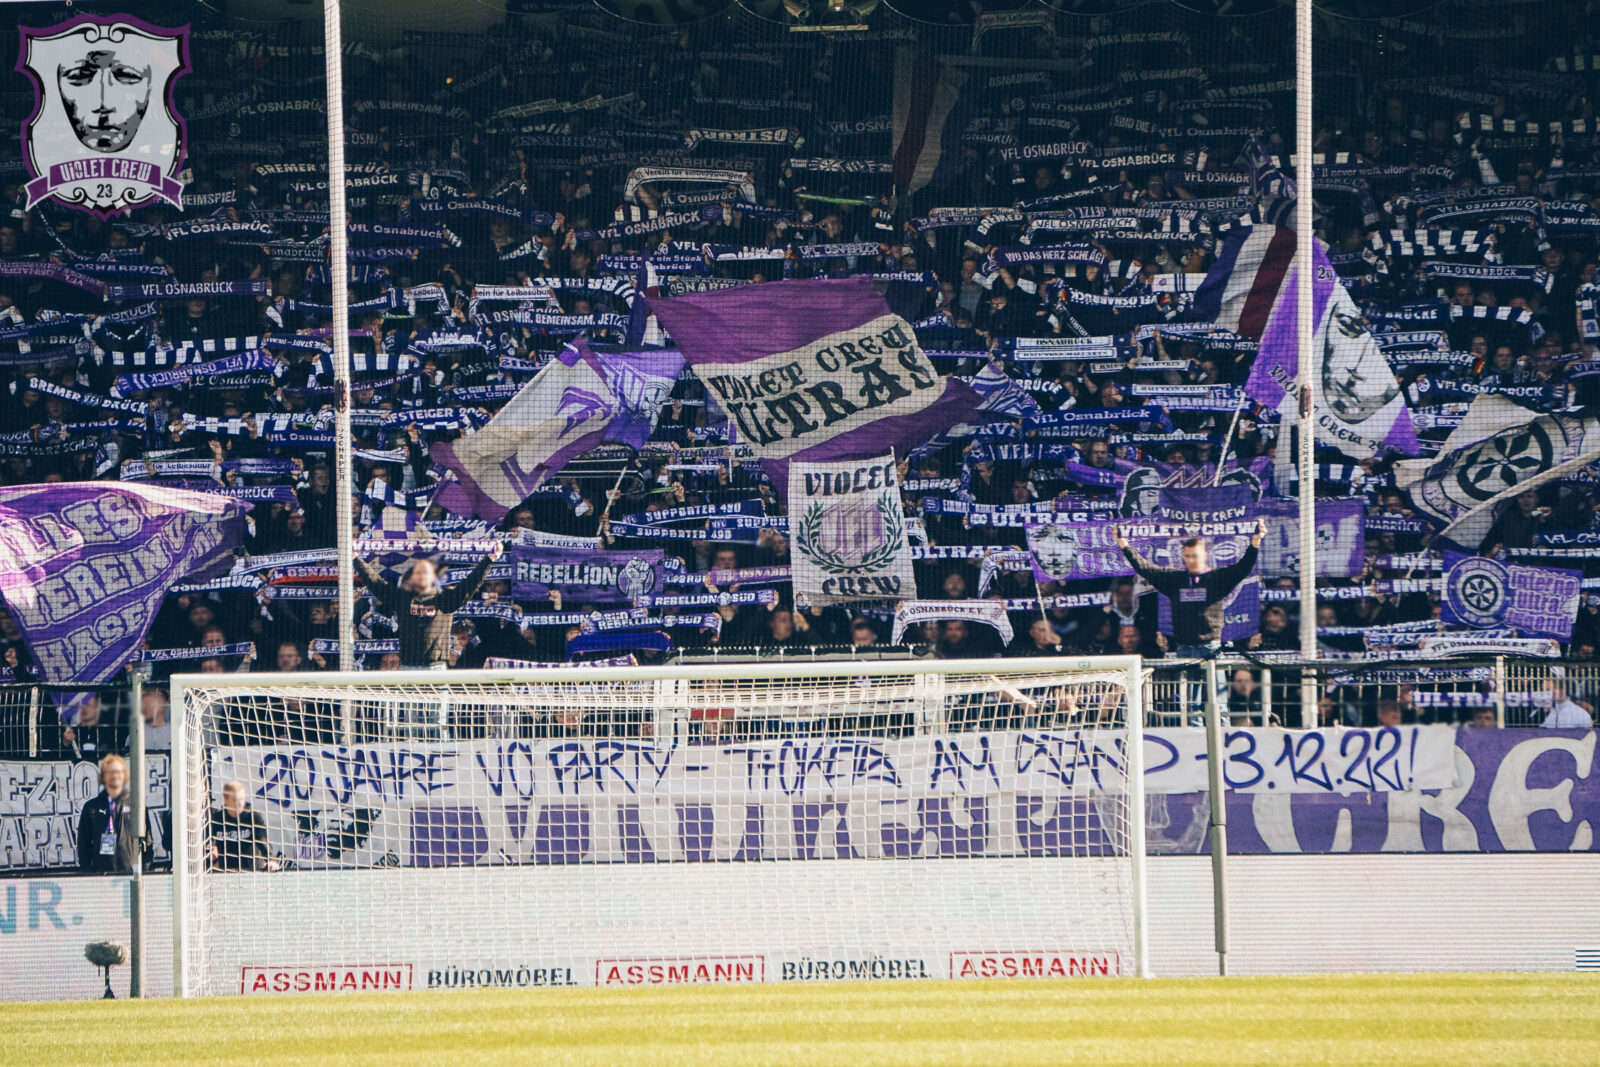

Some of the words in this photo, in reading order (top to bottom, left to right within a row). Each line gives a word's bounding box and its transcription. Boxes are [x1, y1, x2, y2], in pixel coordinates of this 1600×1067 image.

[1000, 147, 1022, 160] VFL
[1078, 158, 1100, 168] VFL
[1101, 152, 1176, 168] OSNABRÜCK
[256, 162, 316, 176] BREMER
[1206, 172, 1250, 184] OSNABR
[447, 200, 523, 218] Osnabrück
[977, 212, 1024, 236] BREMER
[1036, 220, 1058, 228] VFL
[673, 241, 700, 251] VFL
[1023, 251, 1042, 262] DAS
[1043, 249, 1066, 261] HERZ
[141, 284, 162, 296] VFL
[225, 356, 244, 370] VFL
[29, 376, 82, 402] BREMER
[1436, 379, 1460, 392] VFL
[1063, 409, 1150, 422] Osnabrück
[992, 512, 1089, 527] ULTRAS
[1212, 505, 1248, 522] CREW
[1119, 523, 1181, 537] VIOLET
[1198, 521, 1260, 536] CREW
[438, 541, 496, 553] CREW
[821, 574, 902, 597] CREW
[654, 594, 718, 607] REBELLION
[731, 592, 756, 604] SÜD
[1054, 592, 1112, 608] CREW
[526, 614, 590, 626] REBELLION
[676, 614, 702, 625] SÜD
[256, 750, 316, 808] 20
[321, 746, 460, 806] JAHRE
[546, 740, 678, 795] PARTY
[930, 735, 1000, 790] AM
[252, 971, 402, 993] ASSMANN
[427, 964, 578, 989] BÜROMÖBEL
[606, 962, 754, 986] ASSMANN
[782, 956, 931, 980] BÜROMÖBEL
[960, 957, 1110, 978] ASSMANN
